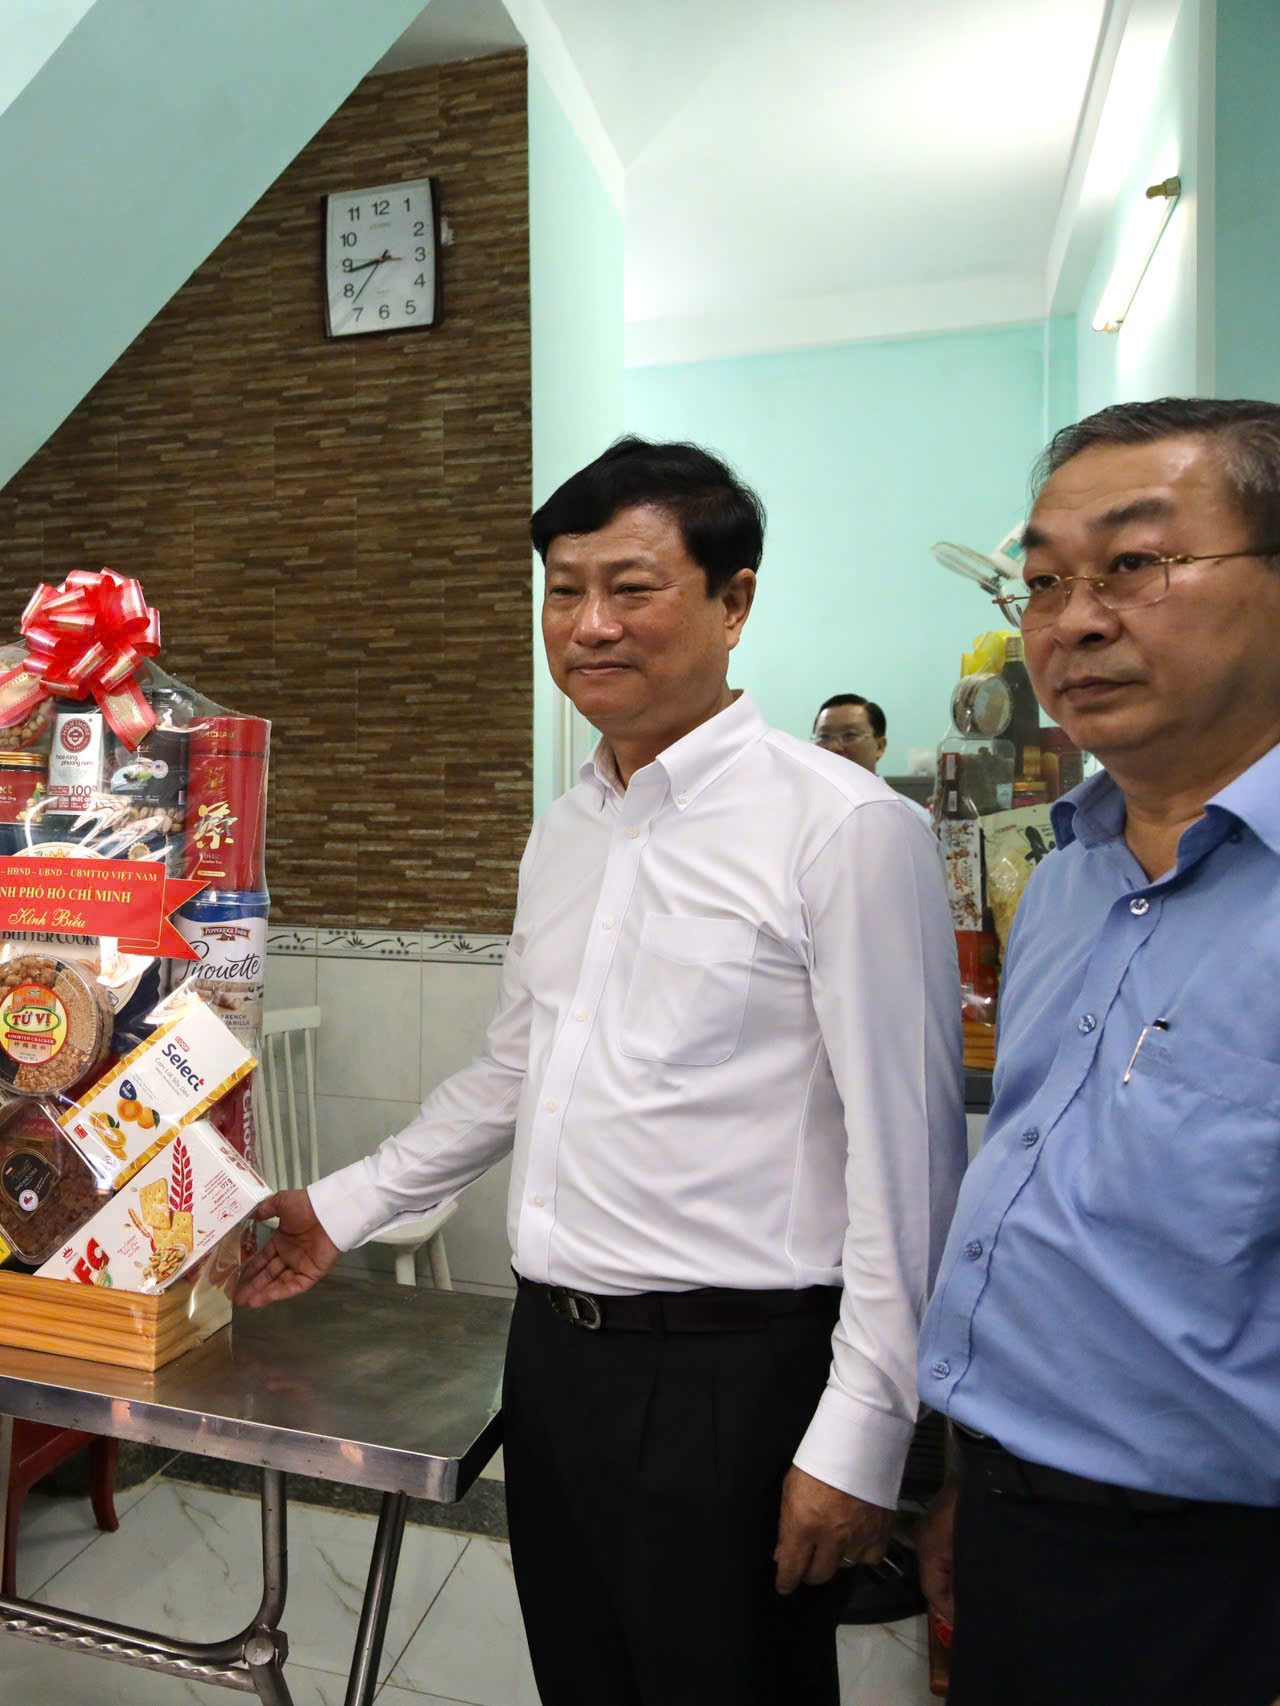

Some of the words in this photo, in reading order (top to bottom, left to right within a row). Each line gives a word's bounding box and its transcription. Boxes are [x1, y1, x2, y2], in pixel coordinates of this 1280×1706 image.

[372, 200, 390, 216] 12
[404, 198, 410, 212] 1
[348, 206, 360, 221] 11
[414, 221, 424, 237] 2
[340, 232, 357, 247] 10
[415, 247, 426, 262] 3
[342, 258, 353, 272] 9
[414, 274, 426, 288] 4
[344, 284, 354, 298] 8
[353, 307, 363, 322] 7
[379, 305, 390, 319] 6
[405, 300, 416, 314] 5
[7, 867, 31, 876] HĐND
[39, 867, 62, 876] UBND
[71, 869, 109, 880] UBMTTQ
[111, 871, 133, 881] VIỆT
[135, 872, 157, 881] NAM
[20, 884, 44, 899] PHỐ
[47, 885, 66, 899] HỒ
[68, 885, 92, 901] CHÍ
[95, 890, 132, 904] MINH
[8, 907, 48, 925] Kính
[51, 908, 86, 928] Biếu
[180, 940, 260, 981] Pirouette
[35, 1012, 51, 1027] VỊ
[162, 1043, 204, 1091] Select
[72, 1236, 110, 1286] FC
